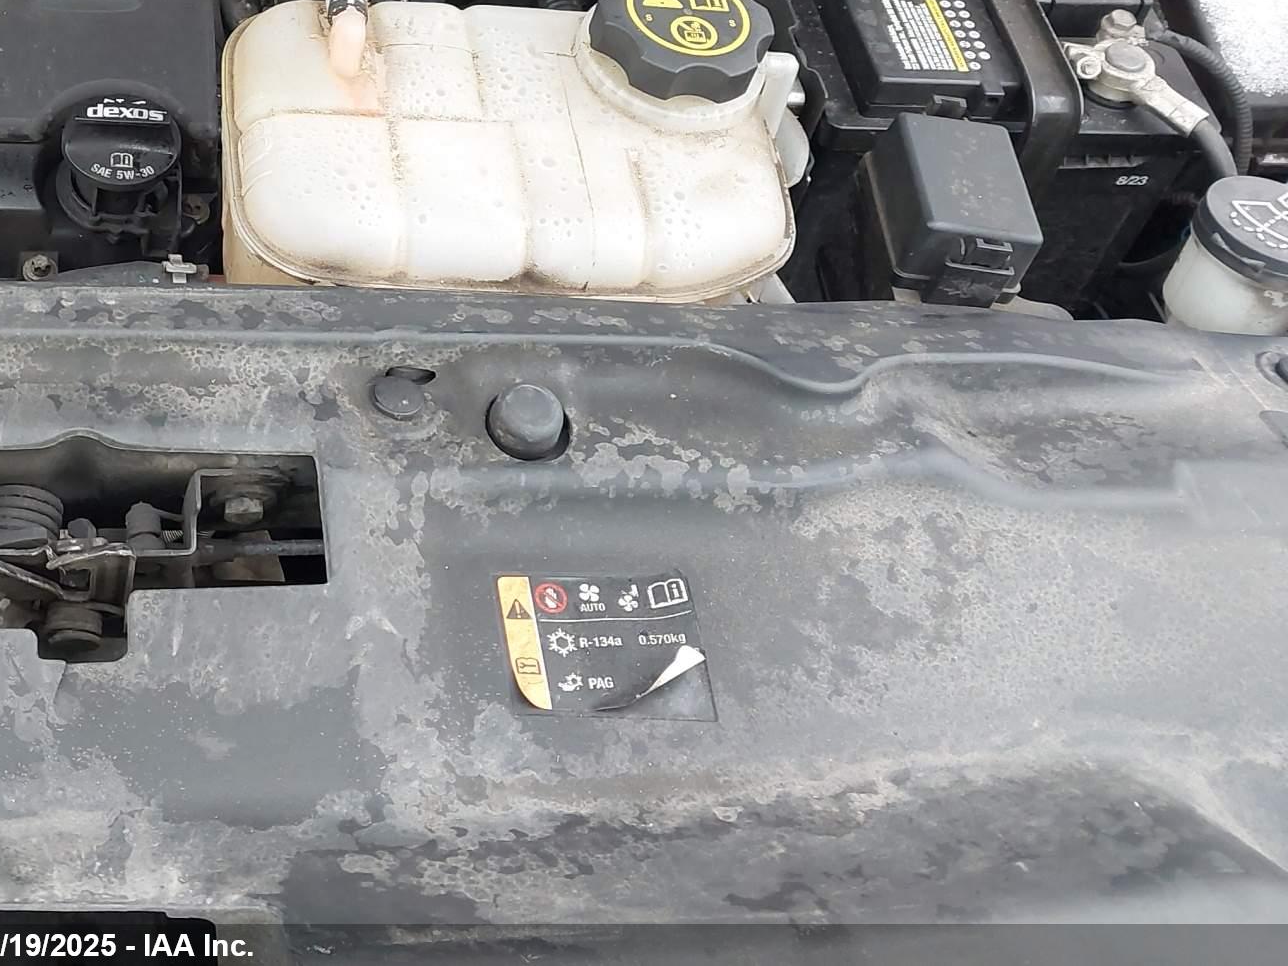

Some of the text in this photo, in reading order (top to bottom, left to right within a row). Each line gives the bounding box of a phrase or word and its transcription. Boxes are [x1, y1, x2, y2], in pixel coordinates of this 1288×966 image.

[86, 103, 168, 122] dexos
[90, 163, 155, 180] SAE 5W-30
[1115, 175, 1149, 186] 8/23
[580, 602, 606, 612] AUTO
[579, 633, 687, 648] R-134a 0.570kg
[588, 676, 614, 690] PAG
